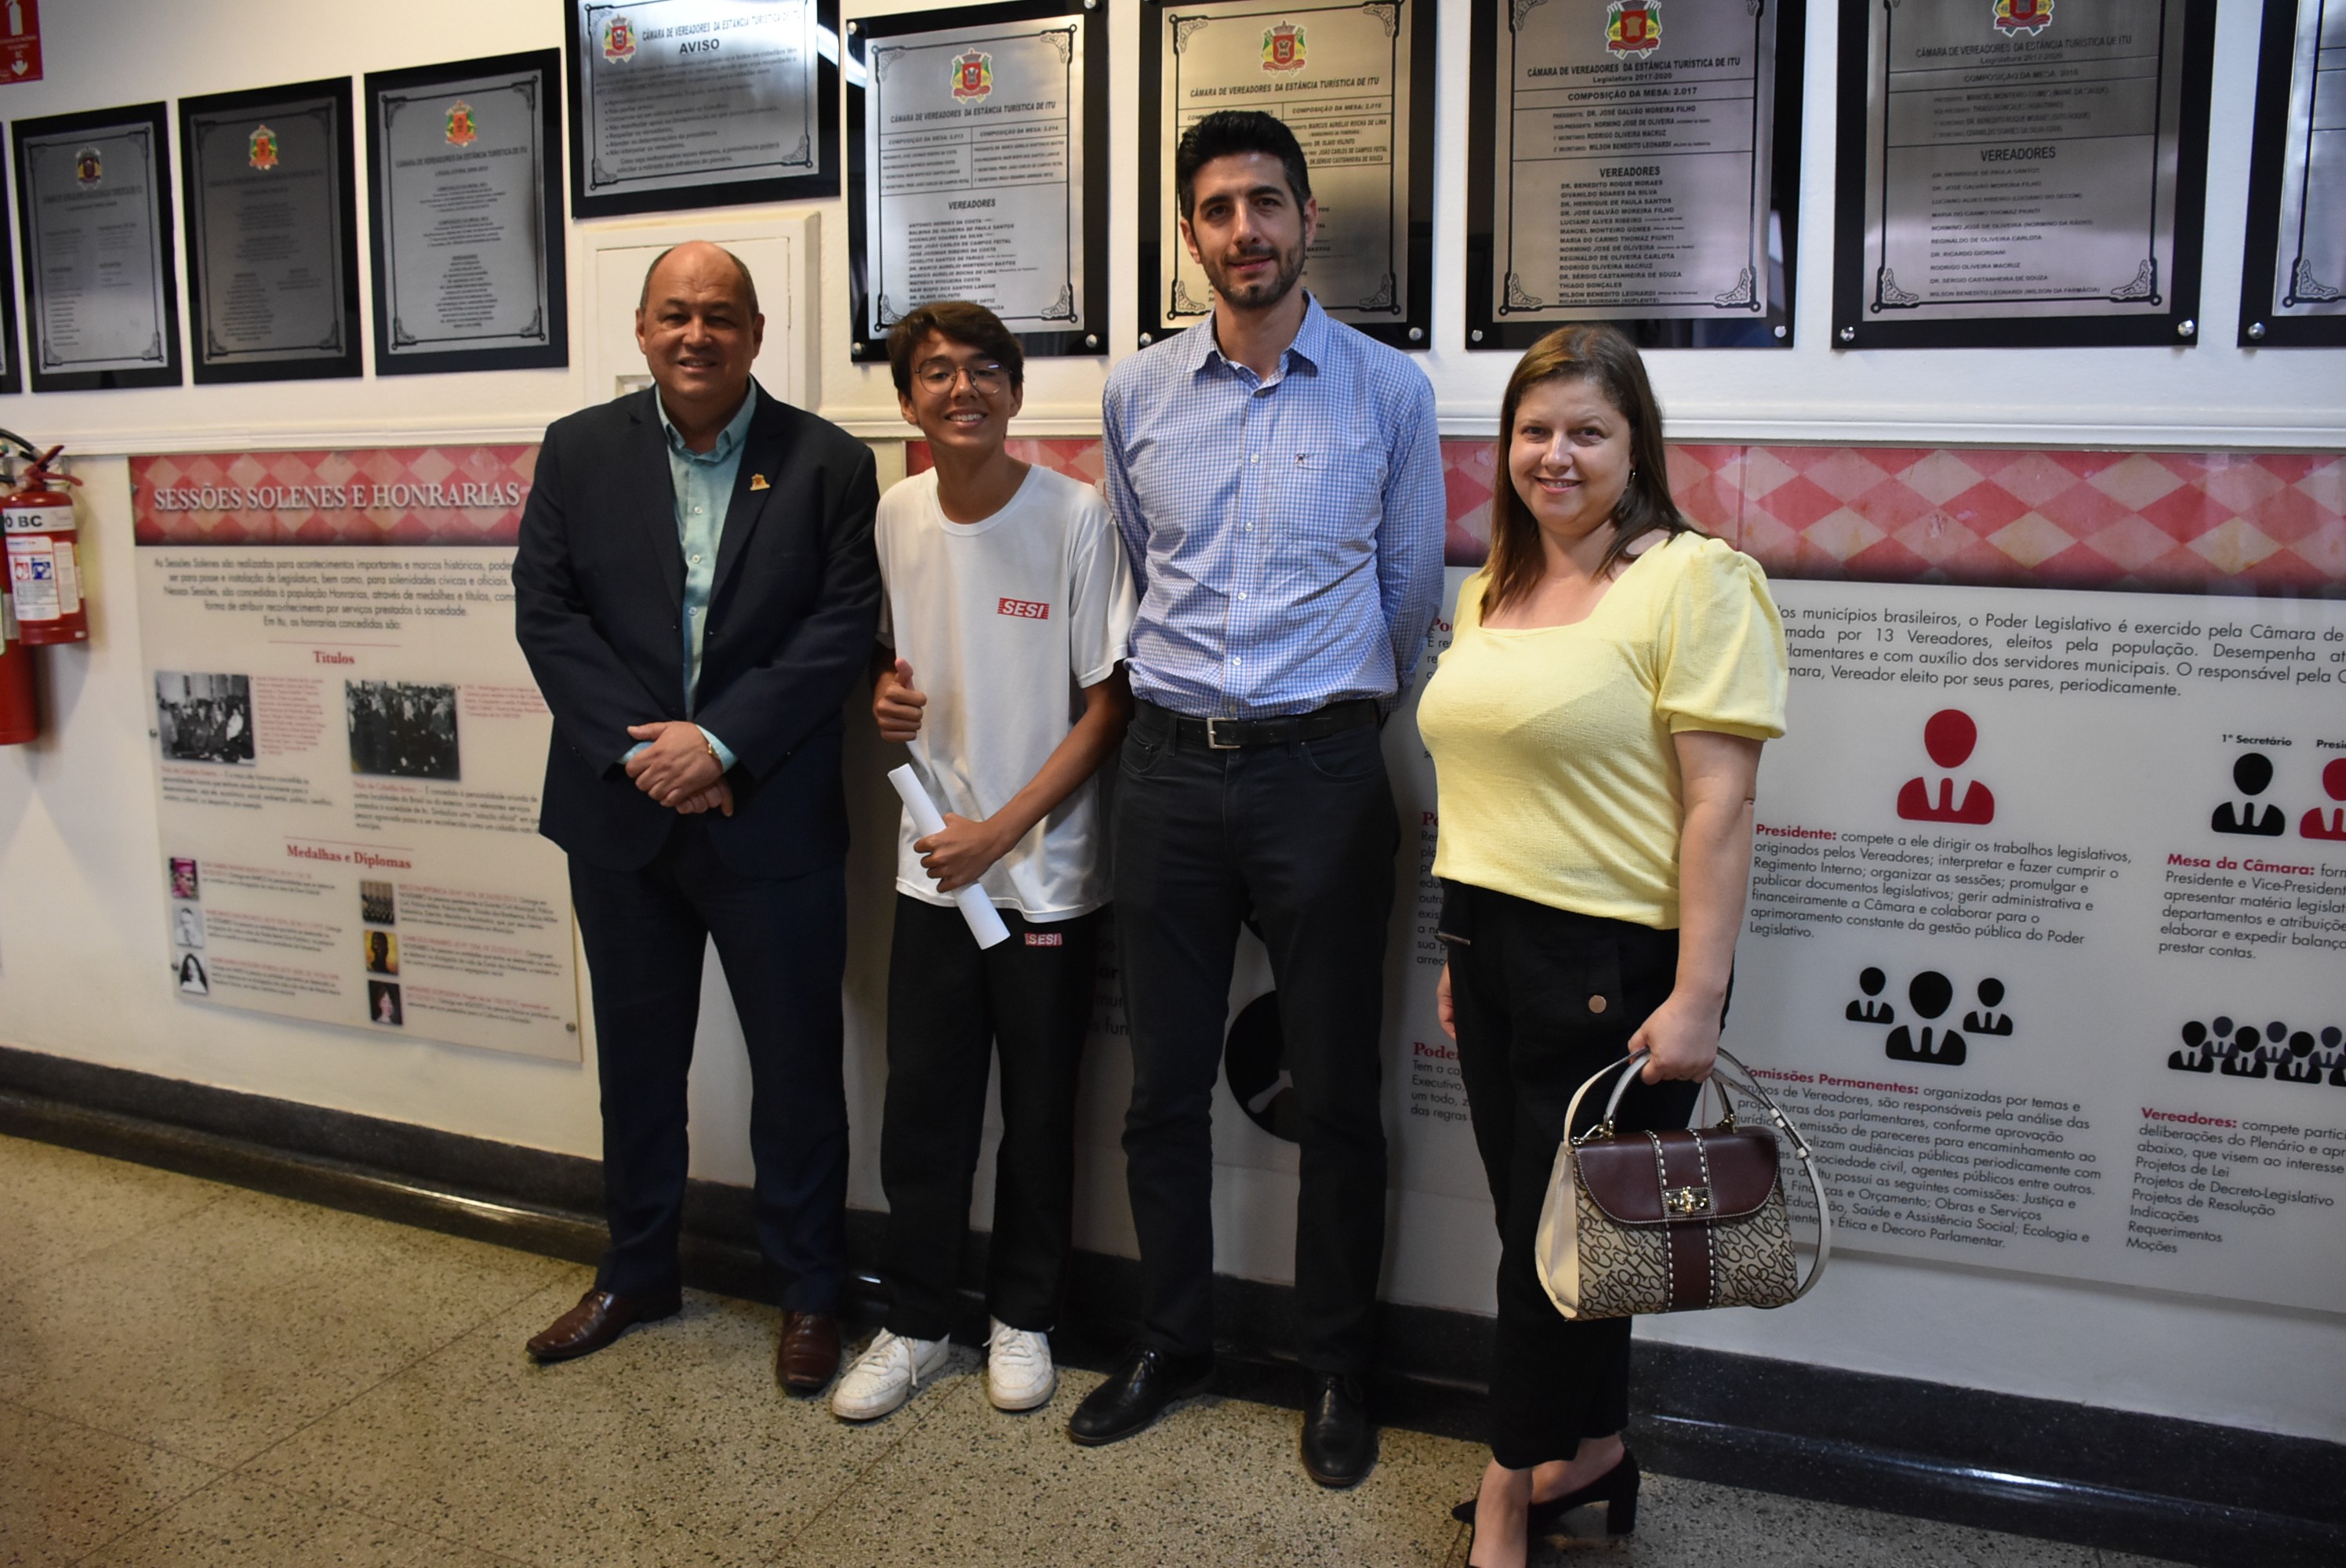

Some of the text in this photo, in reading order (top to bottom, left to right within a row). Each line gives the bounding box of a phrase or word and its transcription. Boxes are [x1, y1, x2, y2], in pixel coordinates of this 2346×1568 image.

[679, 38, 720, 54] AVISO
[1527, 67, 1557, 78] CÂMARA
[1571, 64, 1618, 75] VEREADORES
[1623, 64, 1632, 72] DA
[1634, 60, 1671, 71] ESTÂNCIA
[1673, 58, 1712, 69] TURÍSTICA
[1727, 58, 1740, 67] ITU
[1190, 77, 1379, 97] CÂMARA DE VEREADORES DA ESTÂNCIA TURÍSTICA DE ITU
[1567, 89, 1626, 100] COMPOSIÇÃO
[1643, 89, 1670, 97] MESA:
[891, 113, 913, 123] CÂMARA
[924, 110, 961, 120] VEREADORES
[973, 105, 1001, 116] ESTÂNCIA
[1004, 103, 1034, 113] TURÍSTICA
[1981, 147, 2056, 162] VEREADORES
[1600, 166, 1661, 177] VEREADORES
[948, 198, 996, 210] VEREADORES
[154, 481, 521, 511] SESSÕES SOLENES E HONRARIAS
[18, 516, 42, 527] BC
[1001, 601, 1045, 618] SESI
[1803, 607, 2343, 641] municípios brasileiros, o Poder Legislativo é exercido pela Câmara de
[1838, 629, 2315, 664] por 13 Vereadores, eleitos pela população. Desempenha
[313, 650, 355, 666] Títulos
[1870, 651, 2330, 684] e com auxílio dos servidores municipais. O responsável pela
[1832, 665, 2181, 695] Vereador eleito por seus pares, periodicamente.
[1756, 824, 2130, 864] Presidente: compete a ele dirigir os trabalhos legislativos,
[287, 844, 412, 870] Medalhas e Diplomas
[2167, 855, 2313, 874] Mesa da Câmara:
[2166, 871, 2233, 886] Presidente
[1029, 935, 1058, 946] SESI
[2159, 944, 2255, 958] prestar contas.
[1819, 1073, 1918, 1094] Permanentes:
[1923, 1087, 2001, 1102] organizadas
[2006, 1095, 2027, 1107] por
[2032, 1095, 2068, 1109] temas
[2142, 1107, 2299, 1135] Vereadores: compete
[2136, 1156, 2228, 1176] Projetos de Lei
[2134, 1173, 2333, 1205] Projetos de Decreto-Legislativo
[2133, 1189, 2275, 1217] Projetos de Resolução
[2130, 1205, 2199, 1223] Indicações
[1839, 1214, 1866, 1229] Ética
[1883, 1221, 1925, 1236] Decoro
[1930, 1226, 2006, 1247] Parlamentar.
[2128, 1221, 2222, 1242] Requerimentos
[2126, 1238, 2177, 1253] Moções
